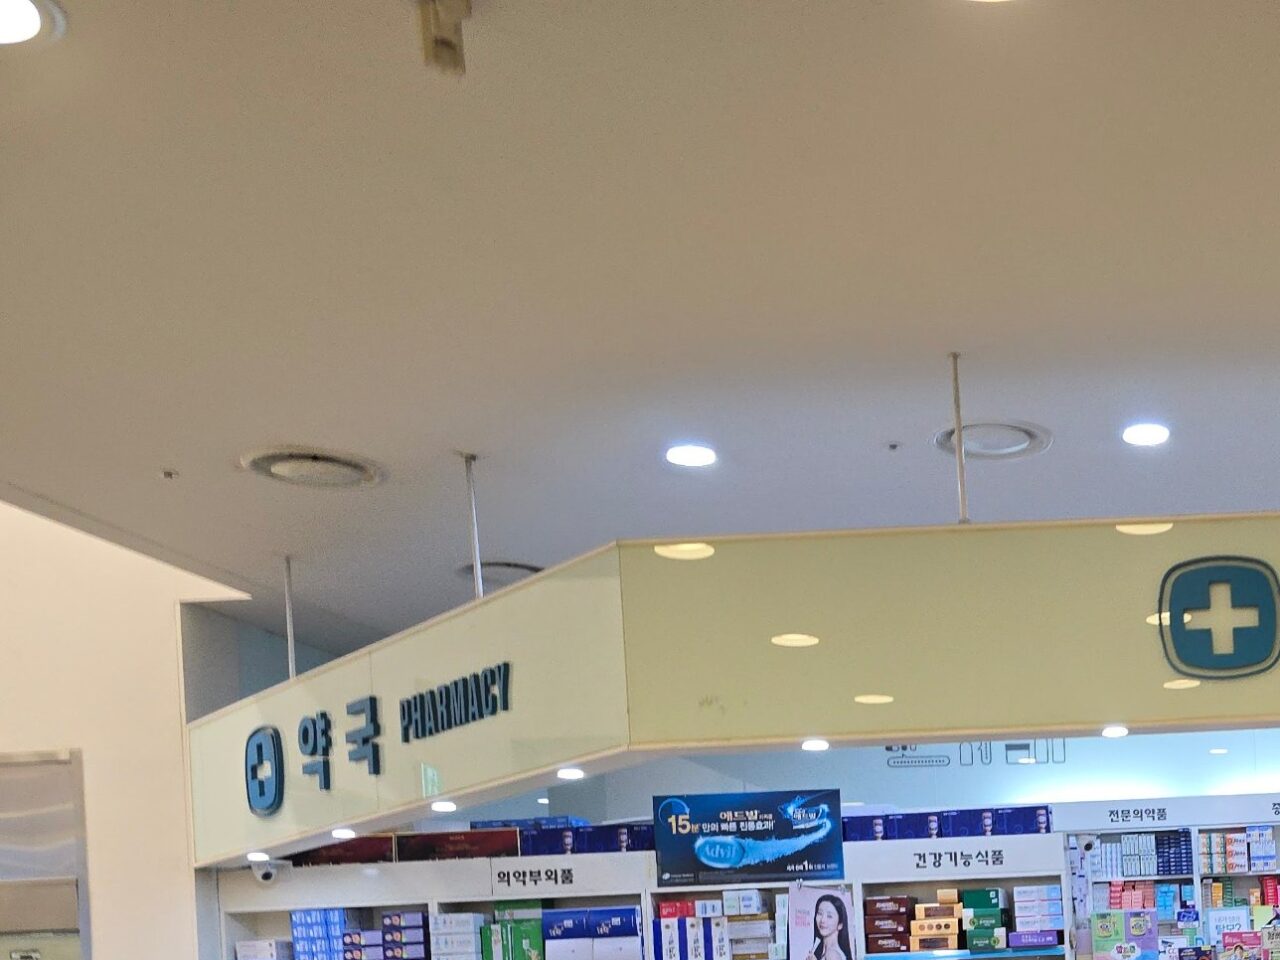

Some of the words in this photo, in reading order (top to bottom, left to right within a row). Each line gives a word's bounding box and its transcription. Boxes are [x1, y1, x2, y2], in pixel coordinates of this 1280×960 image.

[400, 661, 512, 744] PHARMACY
[1107, 807, 1168, 823] 전문의약품
[912, 849, 1005, 869] 건강기능식품
[496, 865, 574, 887] 의약부외품
